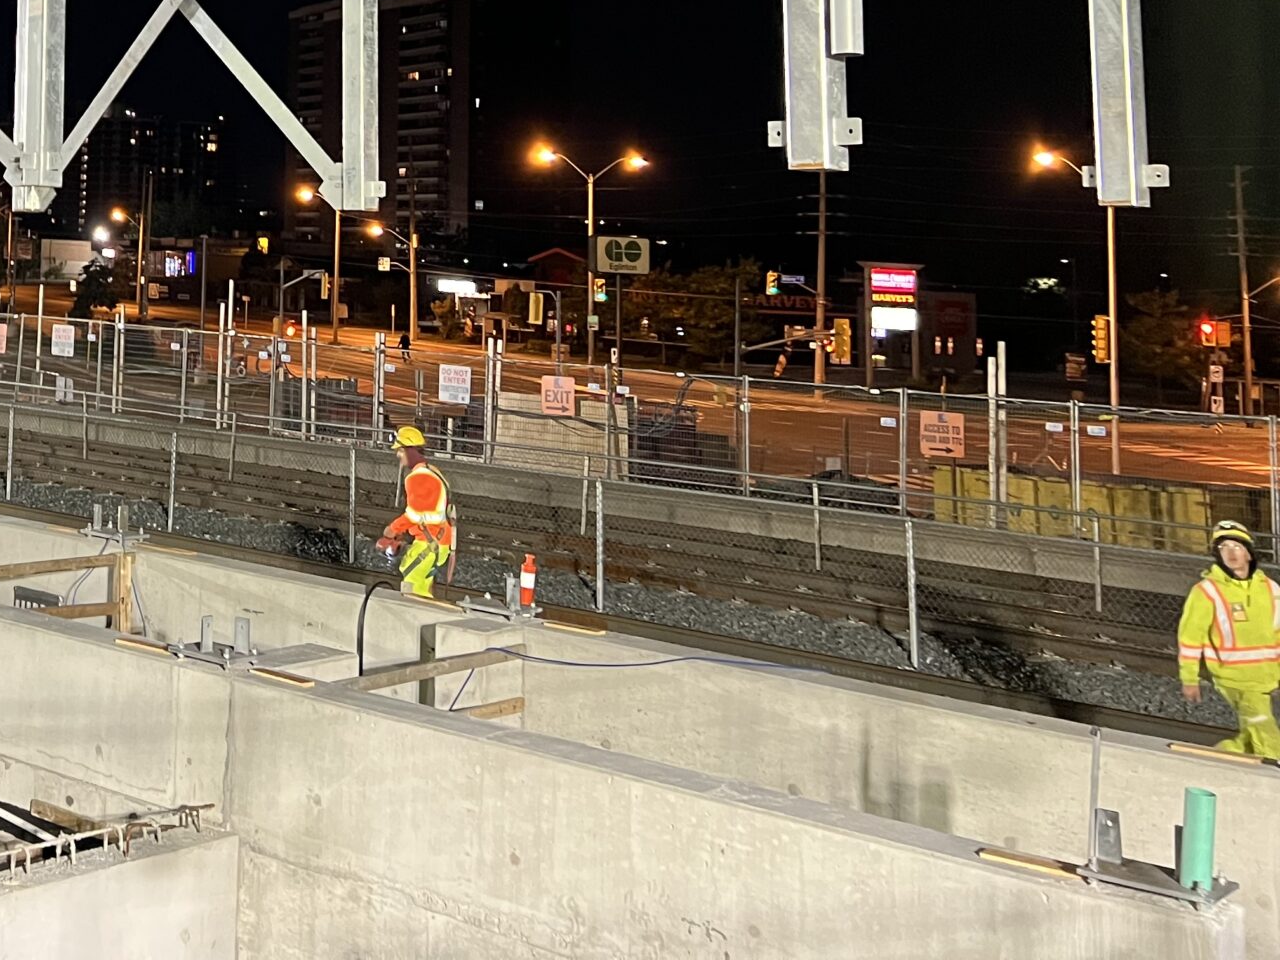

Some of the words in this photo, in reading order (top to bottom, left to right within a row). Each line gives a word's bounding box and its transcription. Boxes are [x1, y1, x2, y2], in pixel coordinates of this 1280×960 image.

[441, 368, 452, 376] DO
[443, 376, 466, 385] ENTER
[545, 389, 571, 404] EXIT
[924, 423, 950, 435] ACCESS
[951, 425, 961, 436] TO
